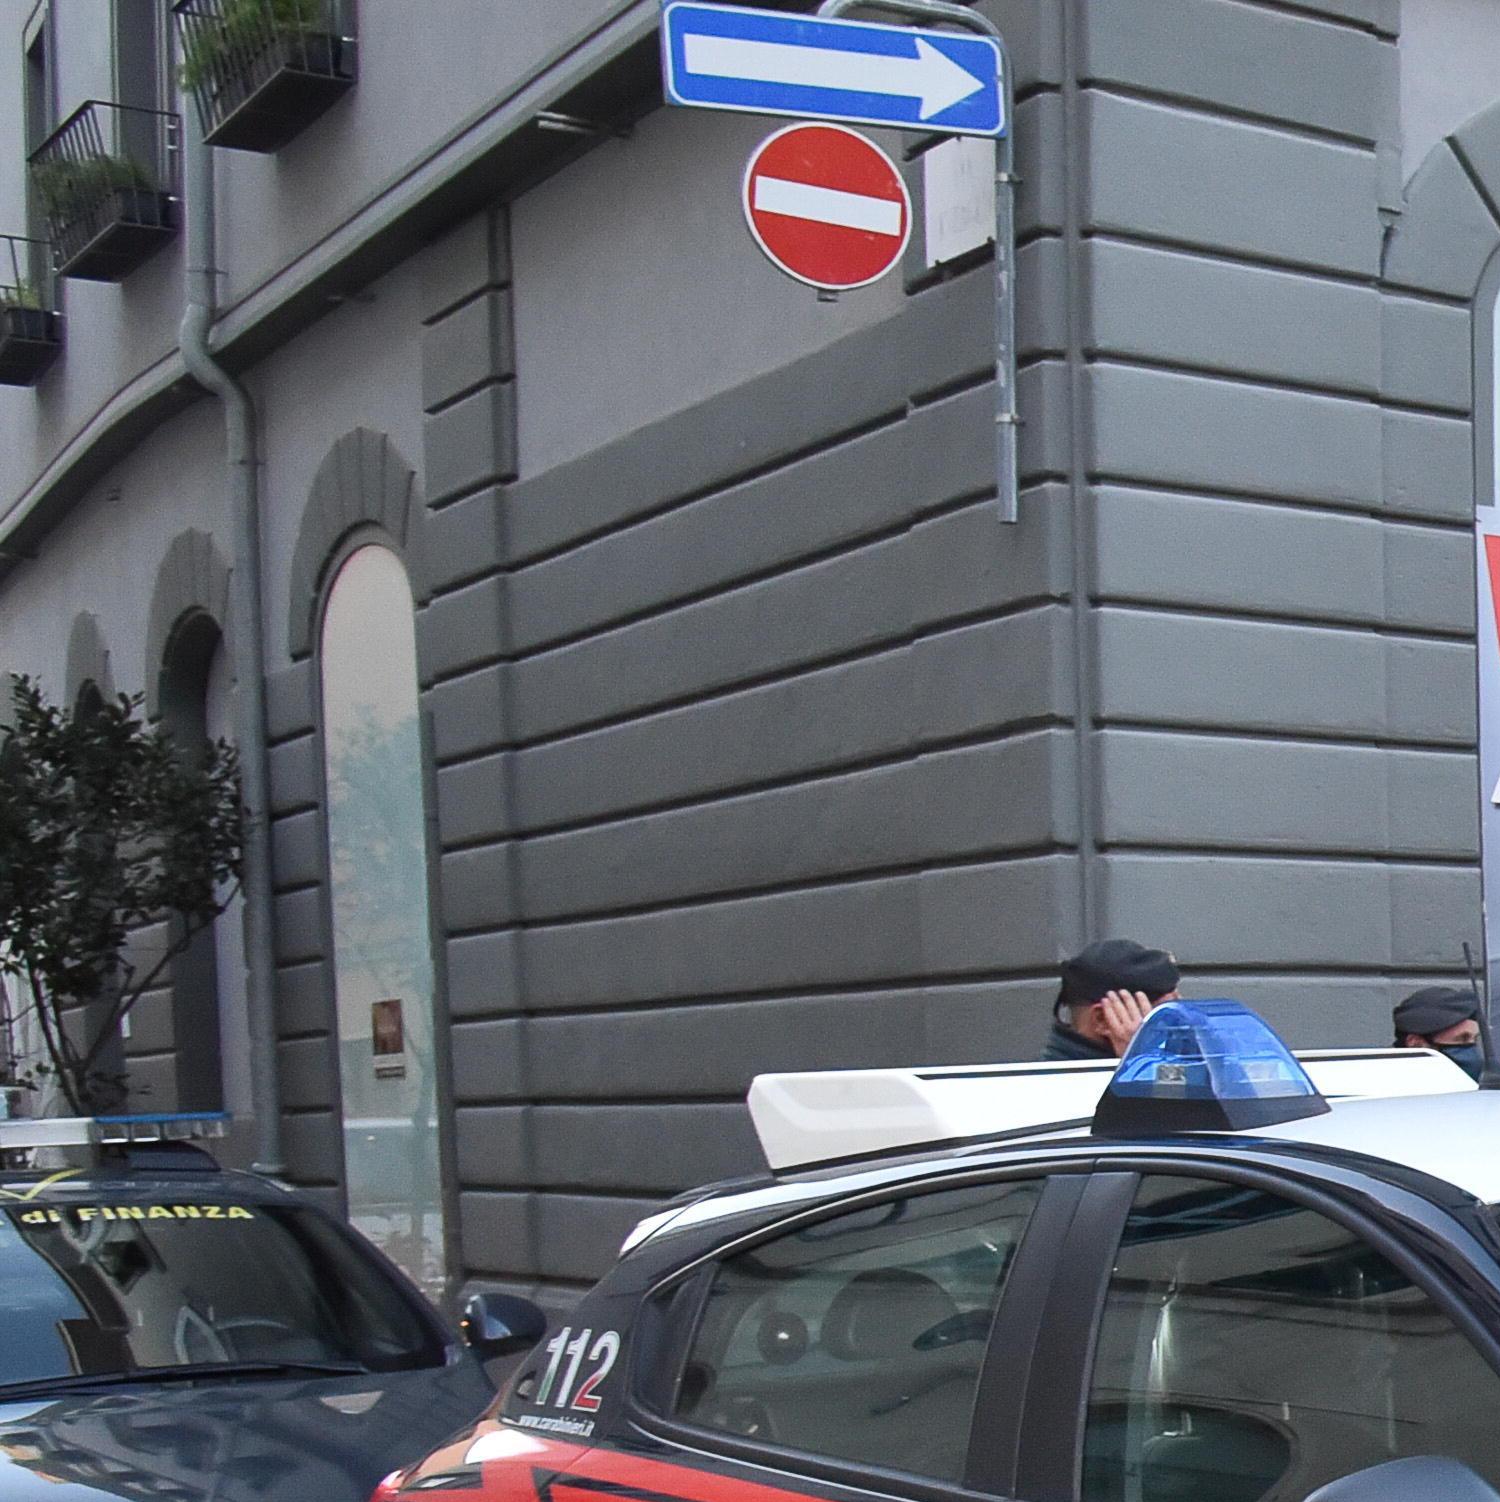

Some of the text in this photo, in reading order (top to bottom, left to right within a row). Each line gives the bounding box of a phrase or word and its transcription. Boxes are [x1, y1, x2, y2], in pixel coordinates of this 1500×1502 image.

[21, 1210, 61, 1224] di
[77, 1206, 254, 1221] FINANZA
[535, 1326, 621, 1413] 112
